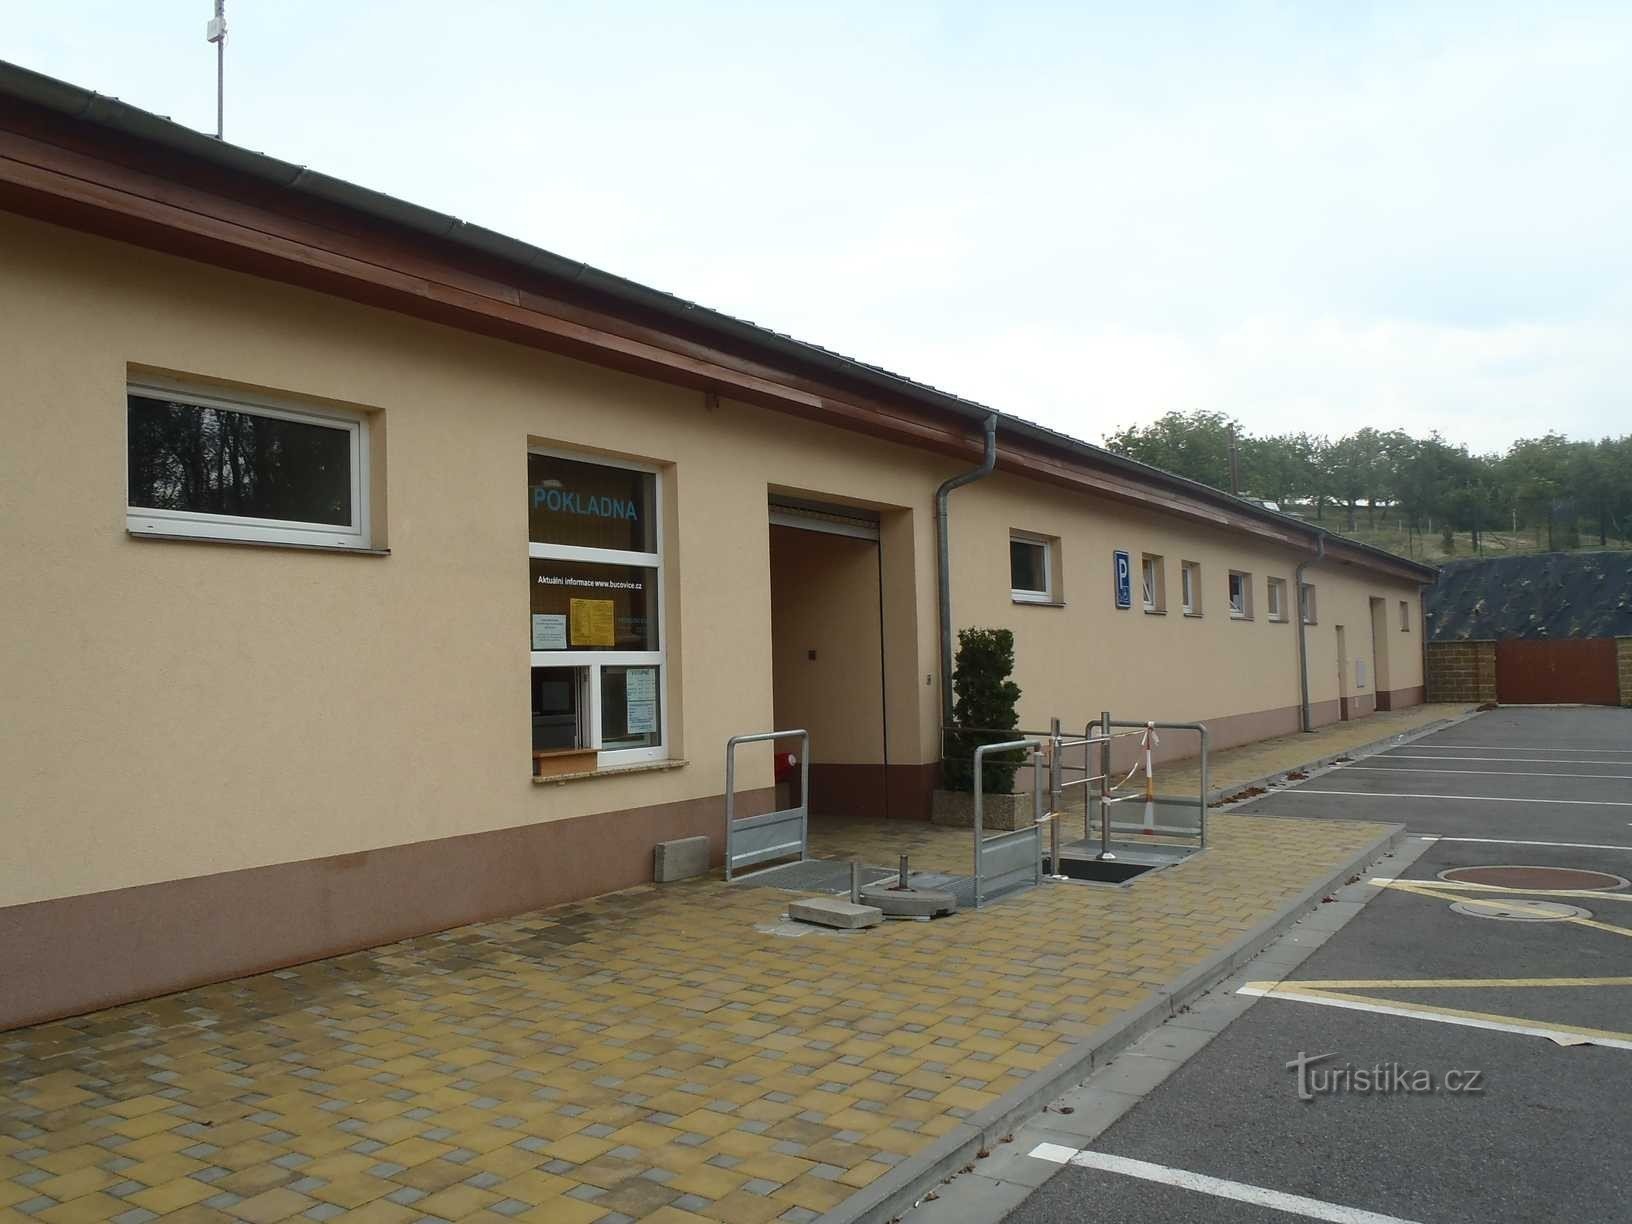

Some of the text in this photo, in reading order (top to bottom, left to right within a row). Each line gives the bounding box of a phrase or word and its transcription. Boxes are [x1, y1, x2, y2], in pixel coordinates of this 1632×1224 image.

[534, 488, 638, 520] POKLADNA
[538, 576, 642, 589] Aktuální informace www.bucovice.cz
[1118, 558, 1127, 590] P
